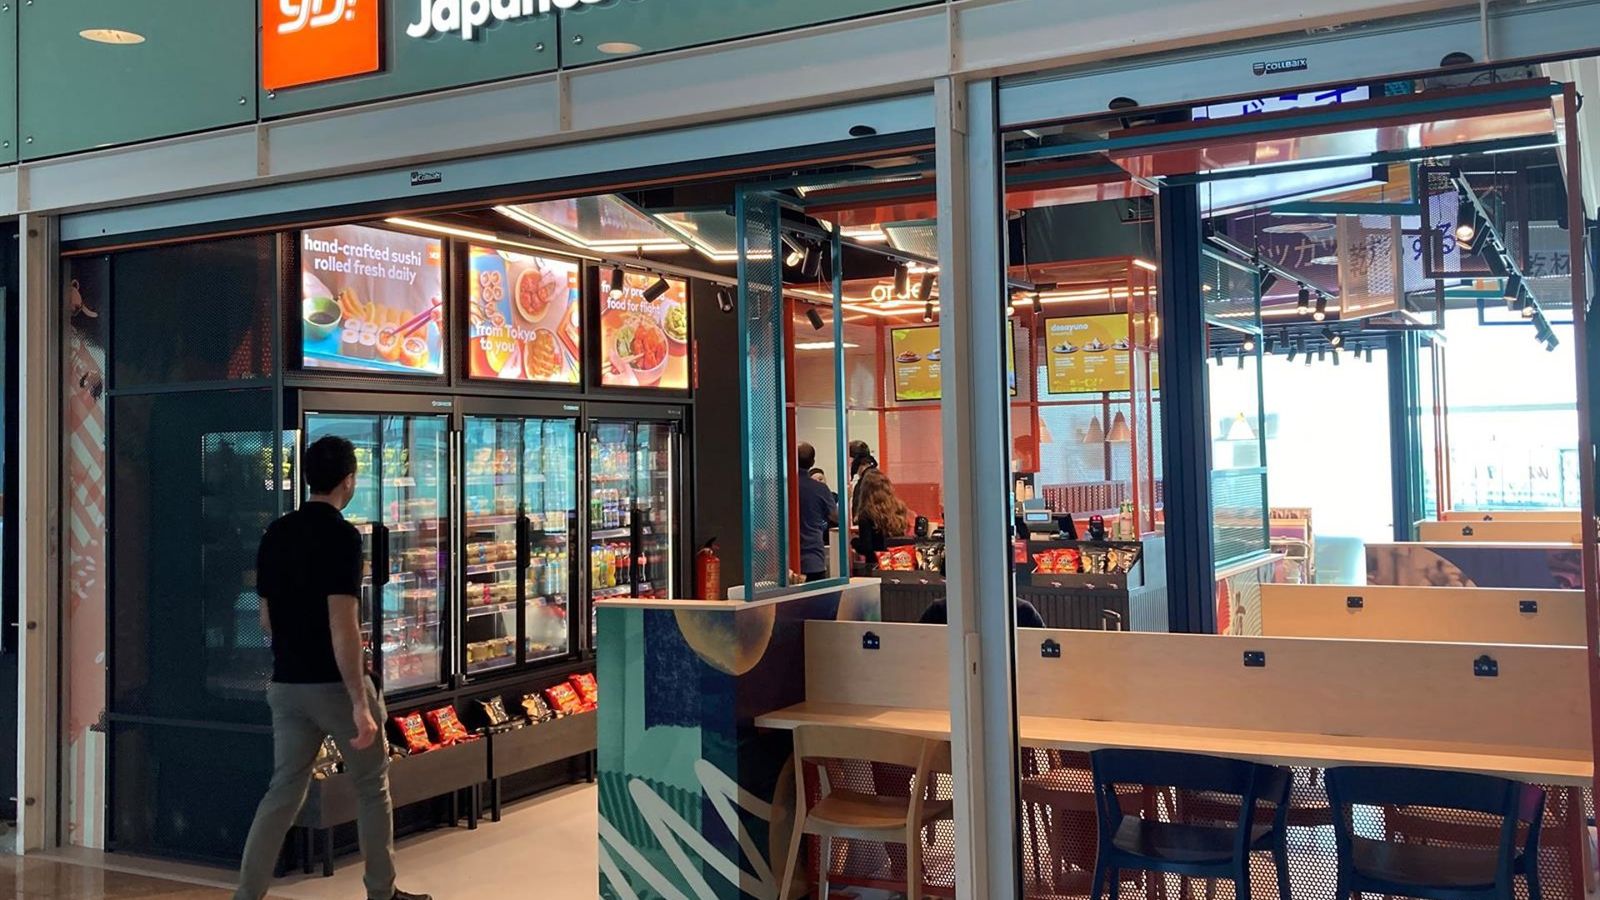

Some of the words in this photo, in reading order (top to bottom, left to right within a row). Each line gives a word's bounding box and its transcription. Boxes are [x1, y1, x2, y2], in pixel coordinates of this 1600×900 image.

[405, 0, 603, 40] Japa
[304, 233, 390, 261] hand-crafted
[391, 251, 421, 266] sushi
[314, 256, 351, 273] rolled
[353, 260, 385, 278] fresh
[388, 264, 416, 286] daily
[607, 296, 626, 310] food
[627, 300, 639, 311] for
[475, 320, 503, 337] from
[506, 325, 537, 342] Tokyo
[480, 337, 493, 351] to
[496, 340, 515, 353] you
